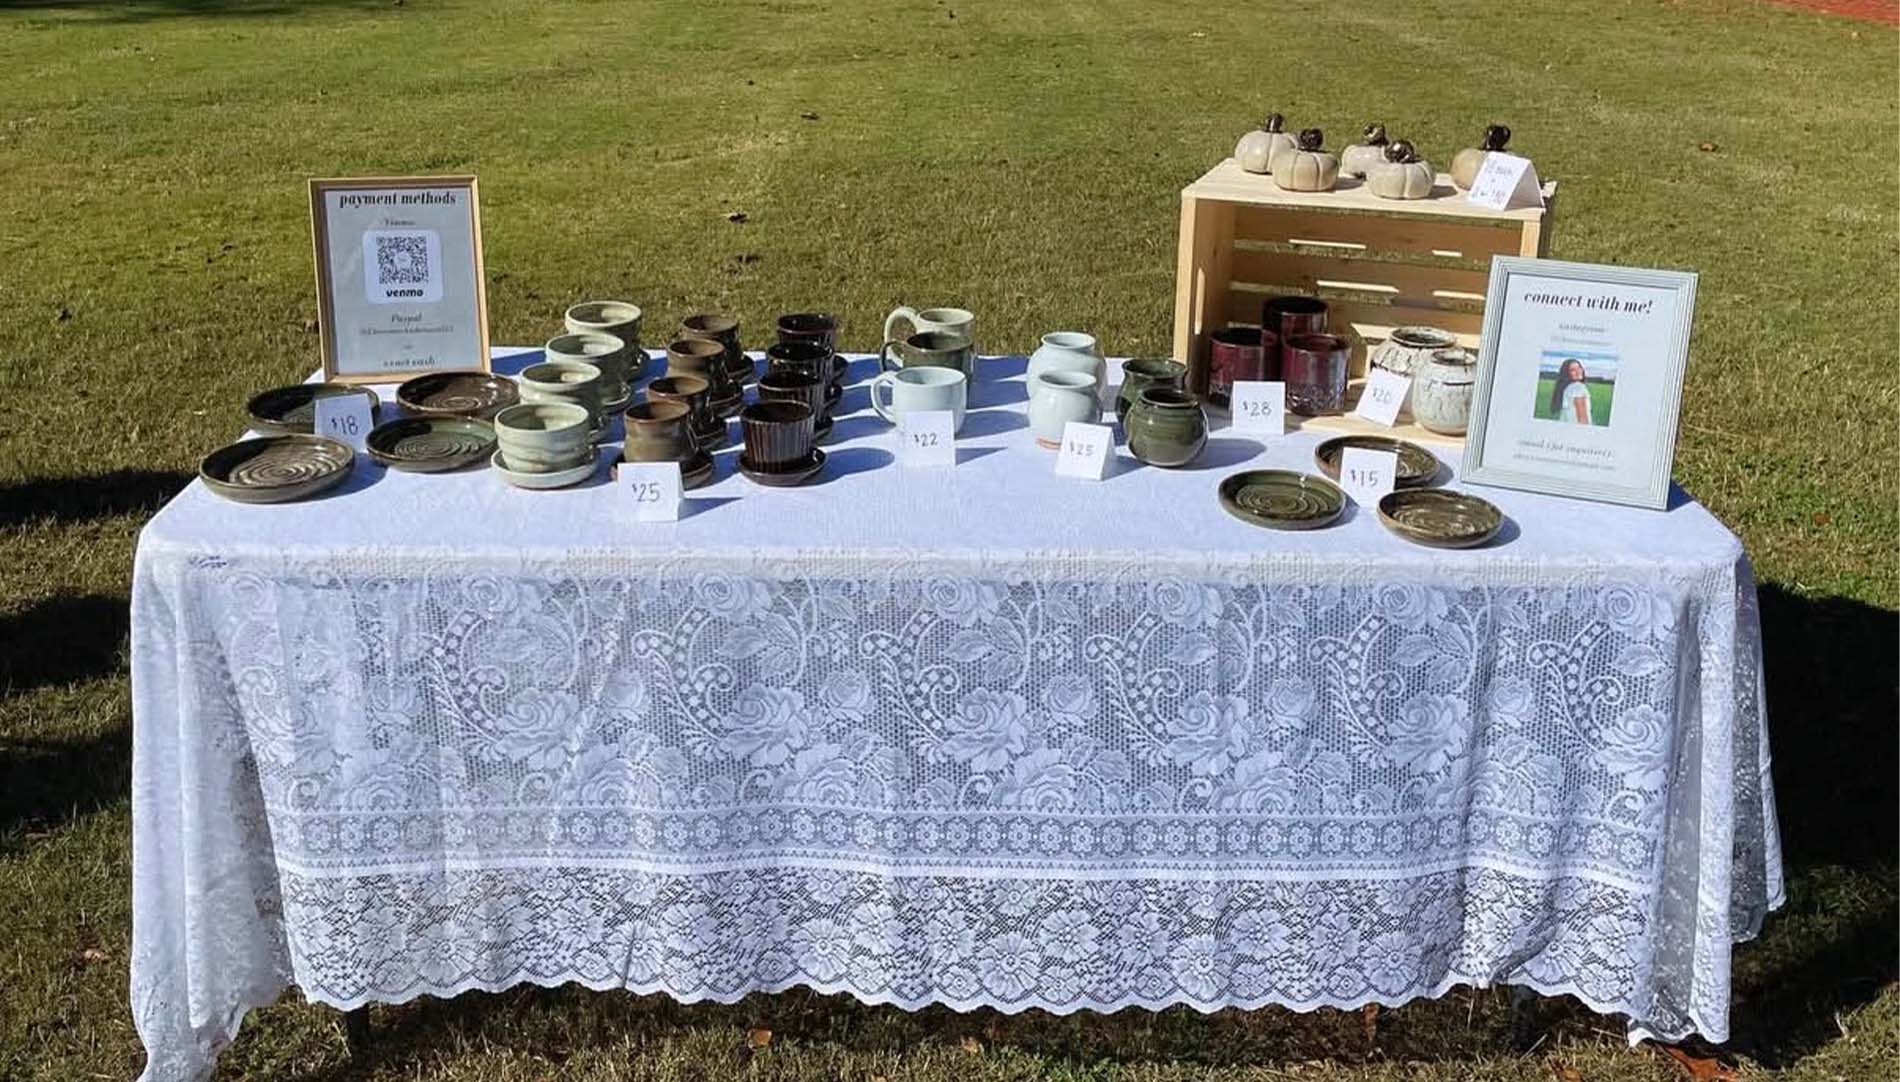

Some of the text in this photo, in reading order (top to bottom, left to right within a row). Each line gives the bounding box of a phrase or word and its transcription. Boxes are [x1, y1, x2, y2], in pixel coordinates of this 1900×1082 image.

[339, 190, 457, 209] payment methods
[385, 288, 424, 298] venmo
[1523, 291, 1653, 314] connect with me!
[1242, 400, 1272, 417] $28
[331, 414, 359, 436] $18
[914, 432, 938, 447] $22
[1070, 441, 1095, 457] $25
[1351, 469, 1379, 487] $15
[632, 481, 661, 502] $25
